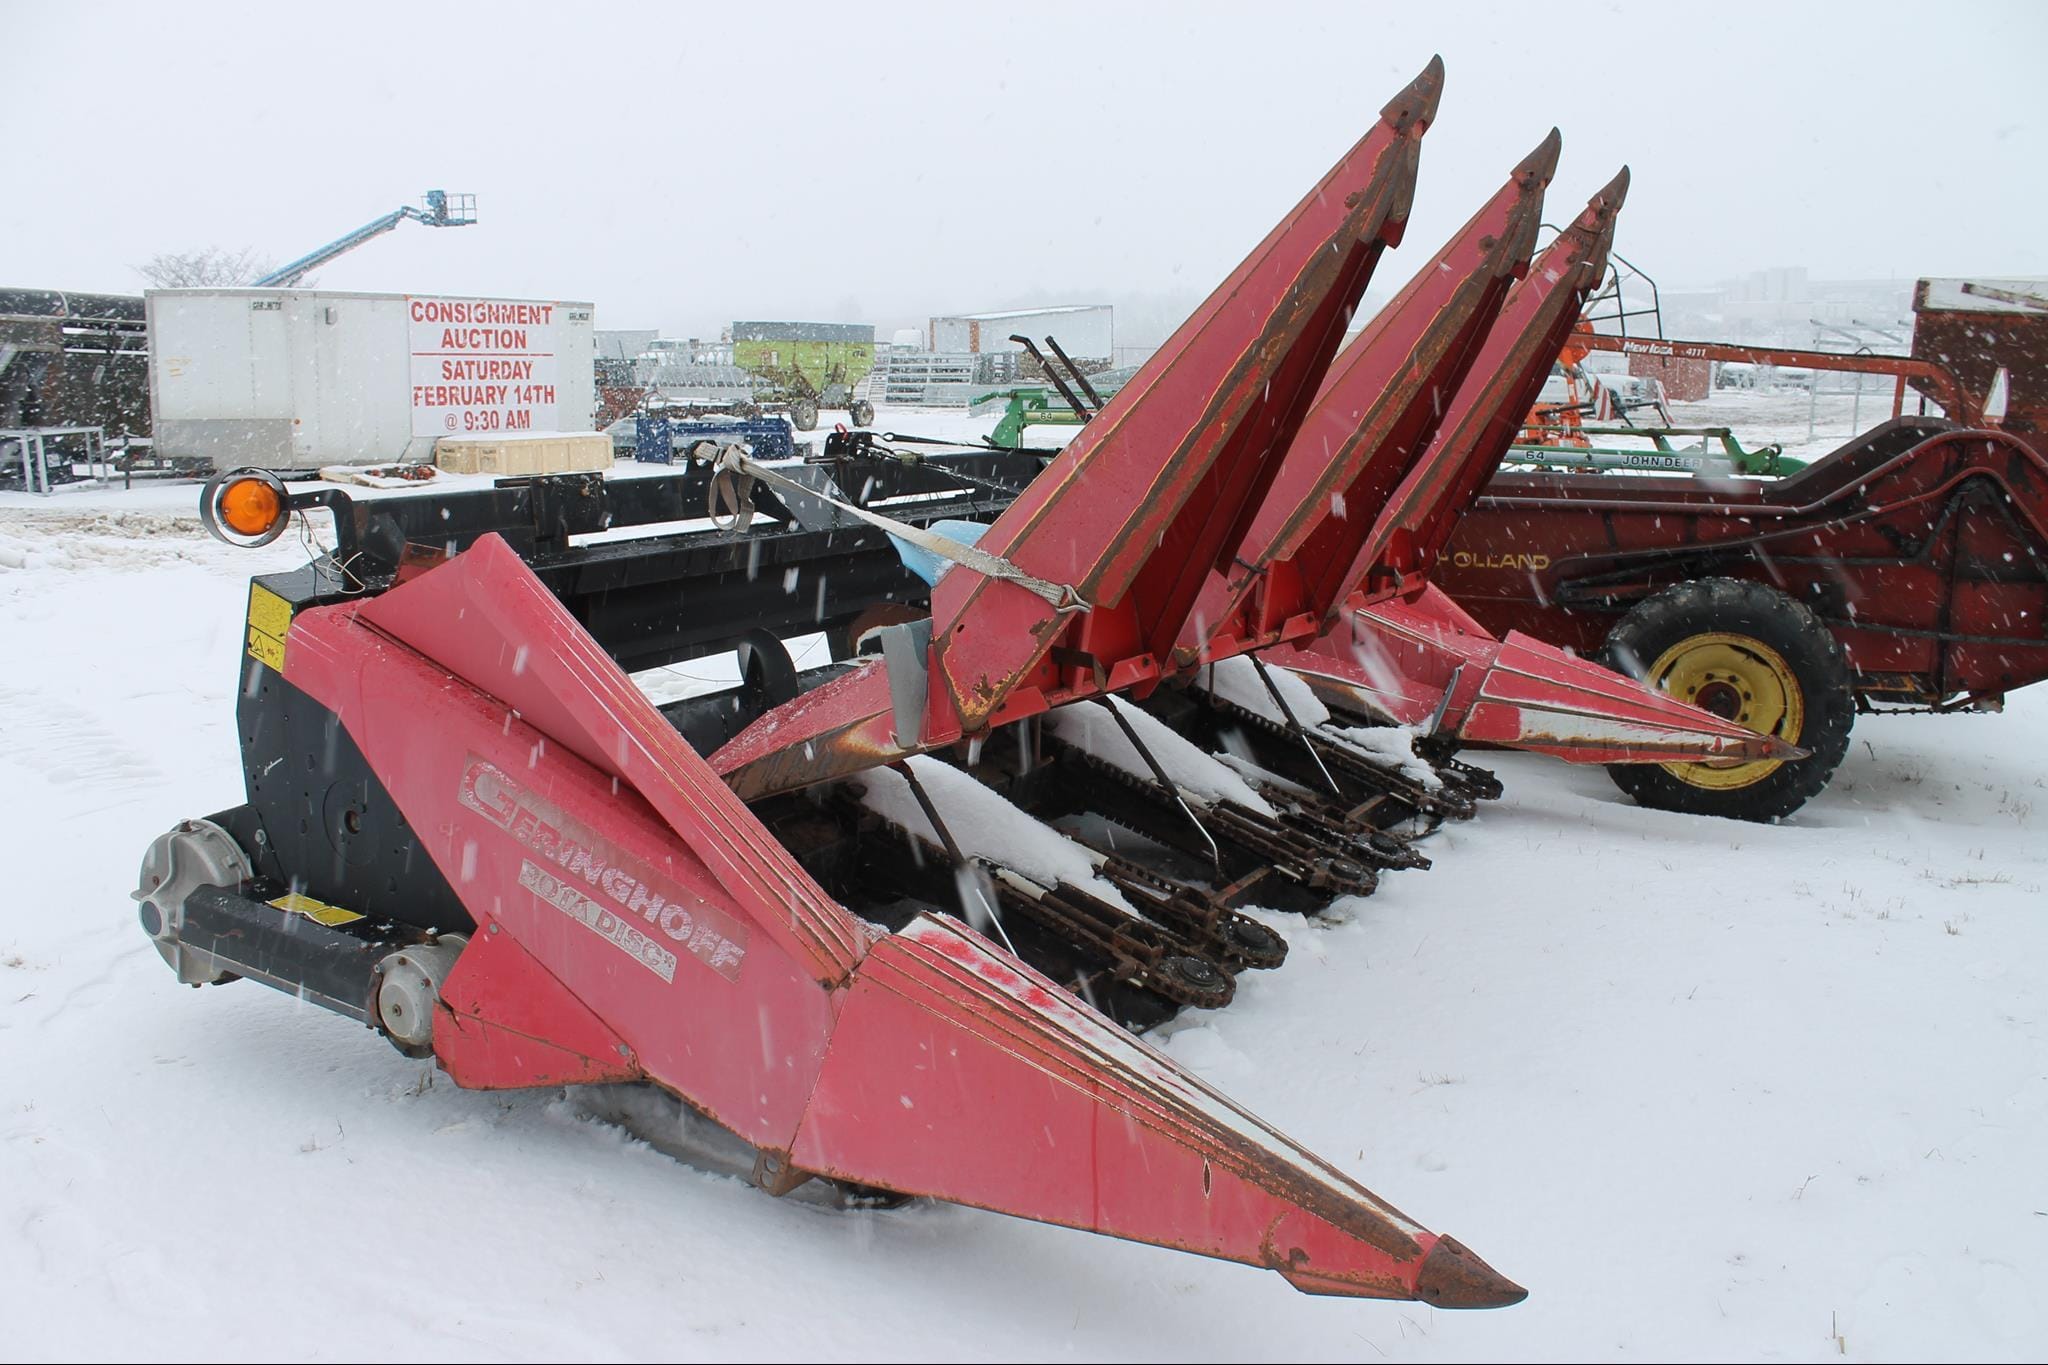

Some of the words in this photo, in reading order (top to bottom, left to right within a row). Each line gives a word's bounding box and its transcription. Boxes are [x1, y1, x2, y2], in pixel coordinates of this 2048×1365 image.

[411, 301, 552, 325] CONSIGNMENT
[441, 328, 527, 349] AUCTION
[1686, 348, 1706, 357] 4111
[442, 360, 533, 381] SATURDAY
[413, 385, 508, 407] FEBRUARY
[514, 385, 555, 405] 14TH
[444, 413, 458, 430] @
[464, 410, 500, 431] 9:30
[505, 410, 531, 429] AM
[1040, 412, 1052, 421] 64
[1525, 451, 1545, 461] 64
[1622, 455, 1659, 467] JOHN
[464, 760, 745, 967] GERINGHOFF
